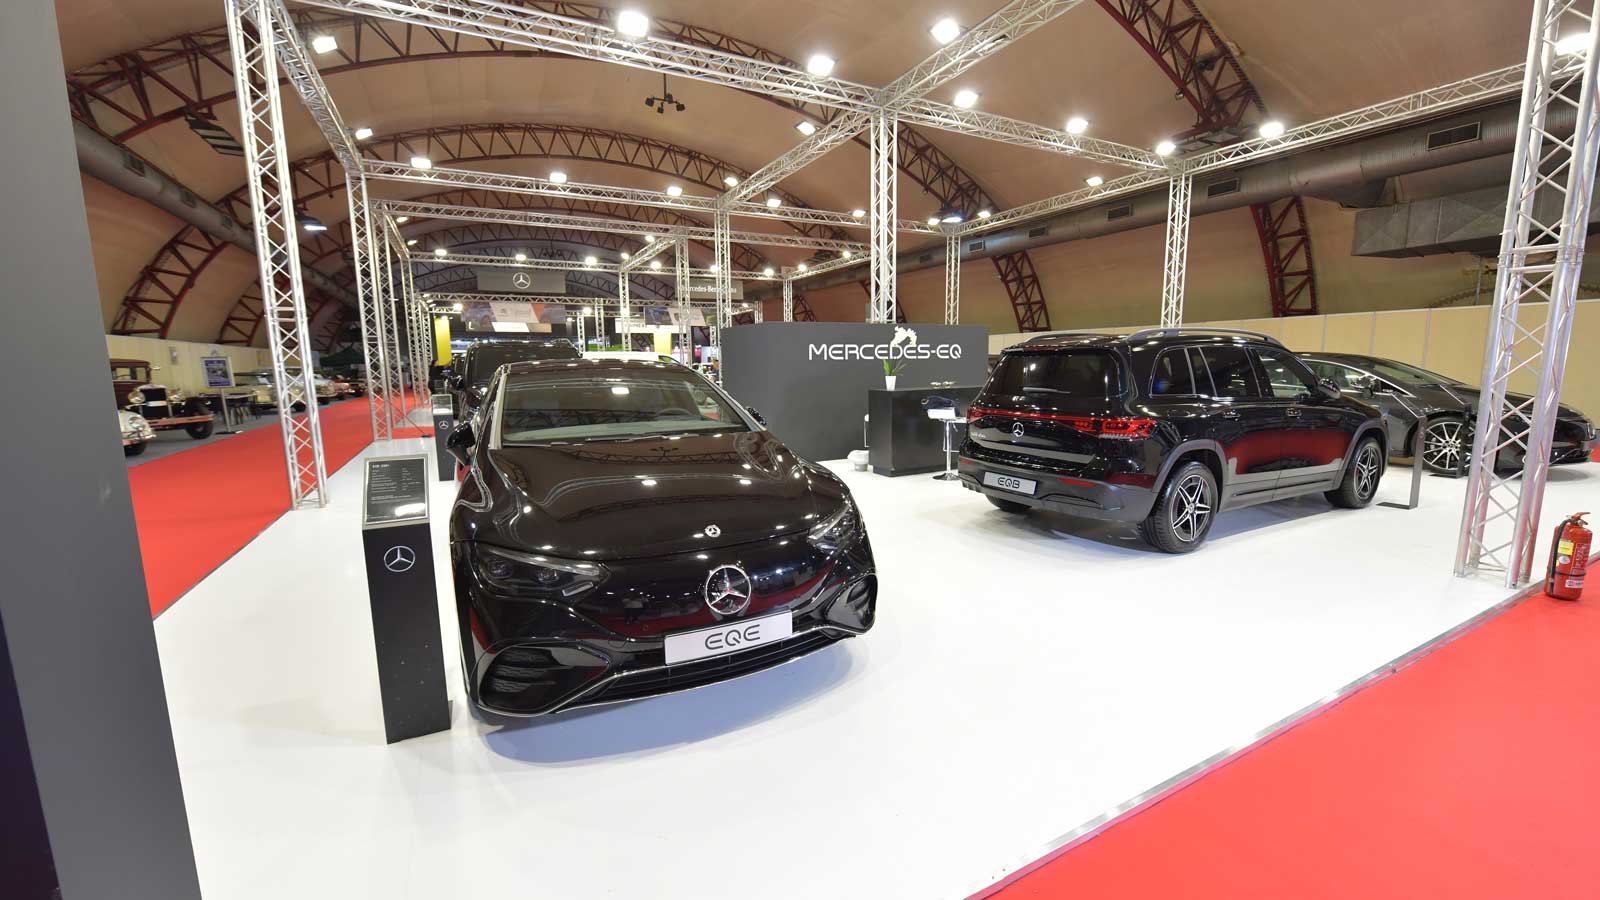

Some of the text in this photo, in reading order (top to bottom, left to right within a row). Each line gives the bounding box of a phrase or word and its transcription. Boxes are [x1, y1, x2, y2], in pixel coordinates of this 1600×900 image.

[808, 343, 962, 360] MERCEDES-EQ
[997, 477, 1020, 489] EQB
[705, 624, 761, 650] EQE
